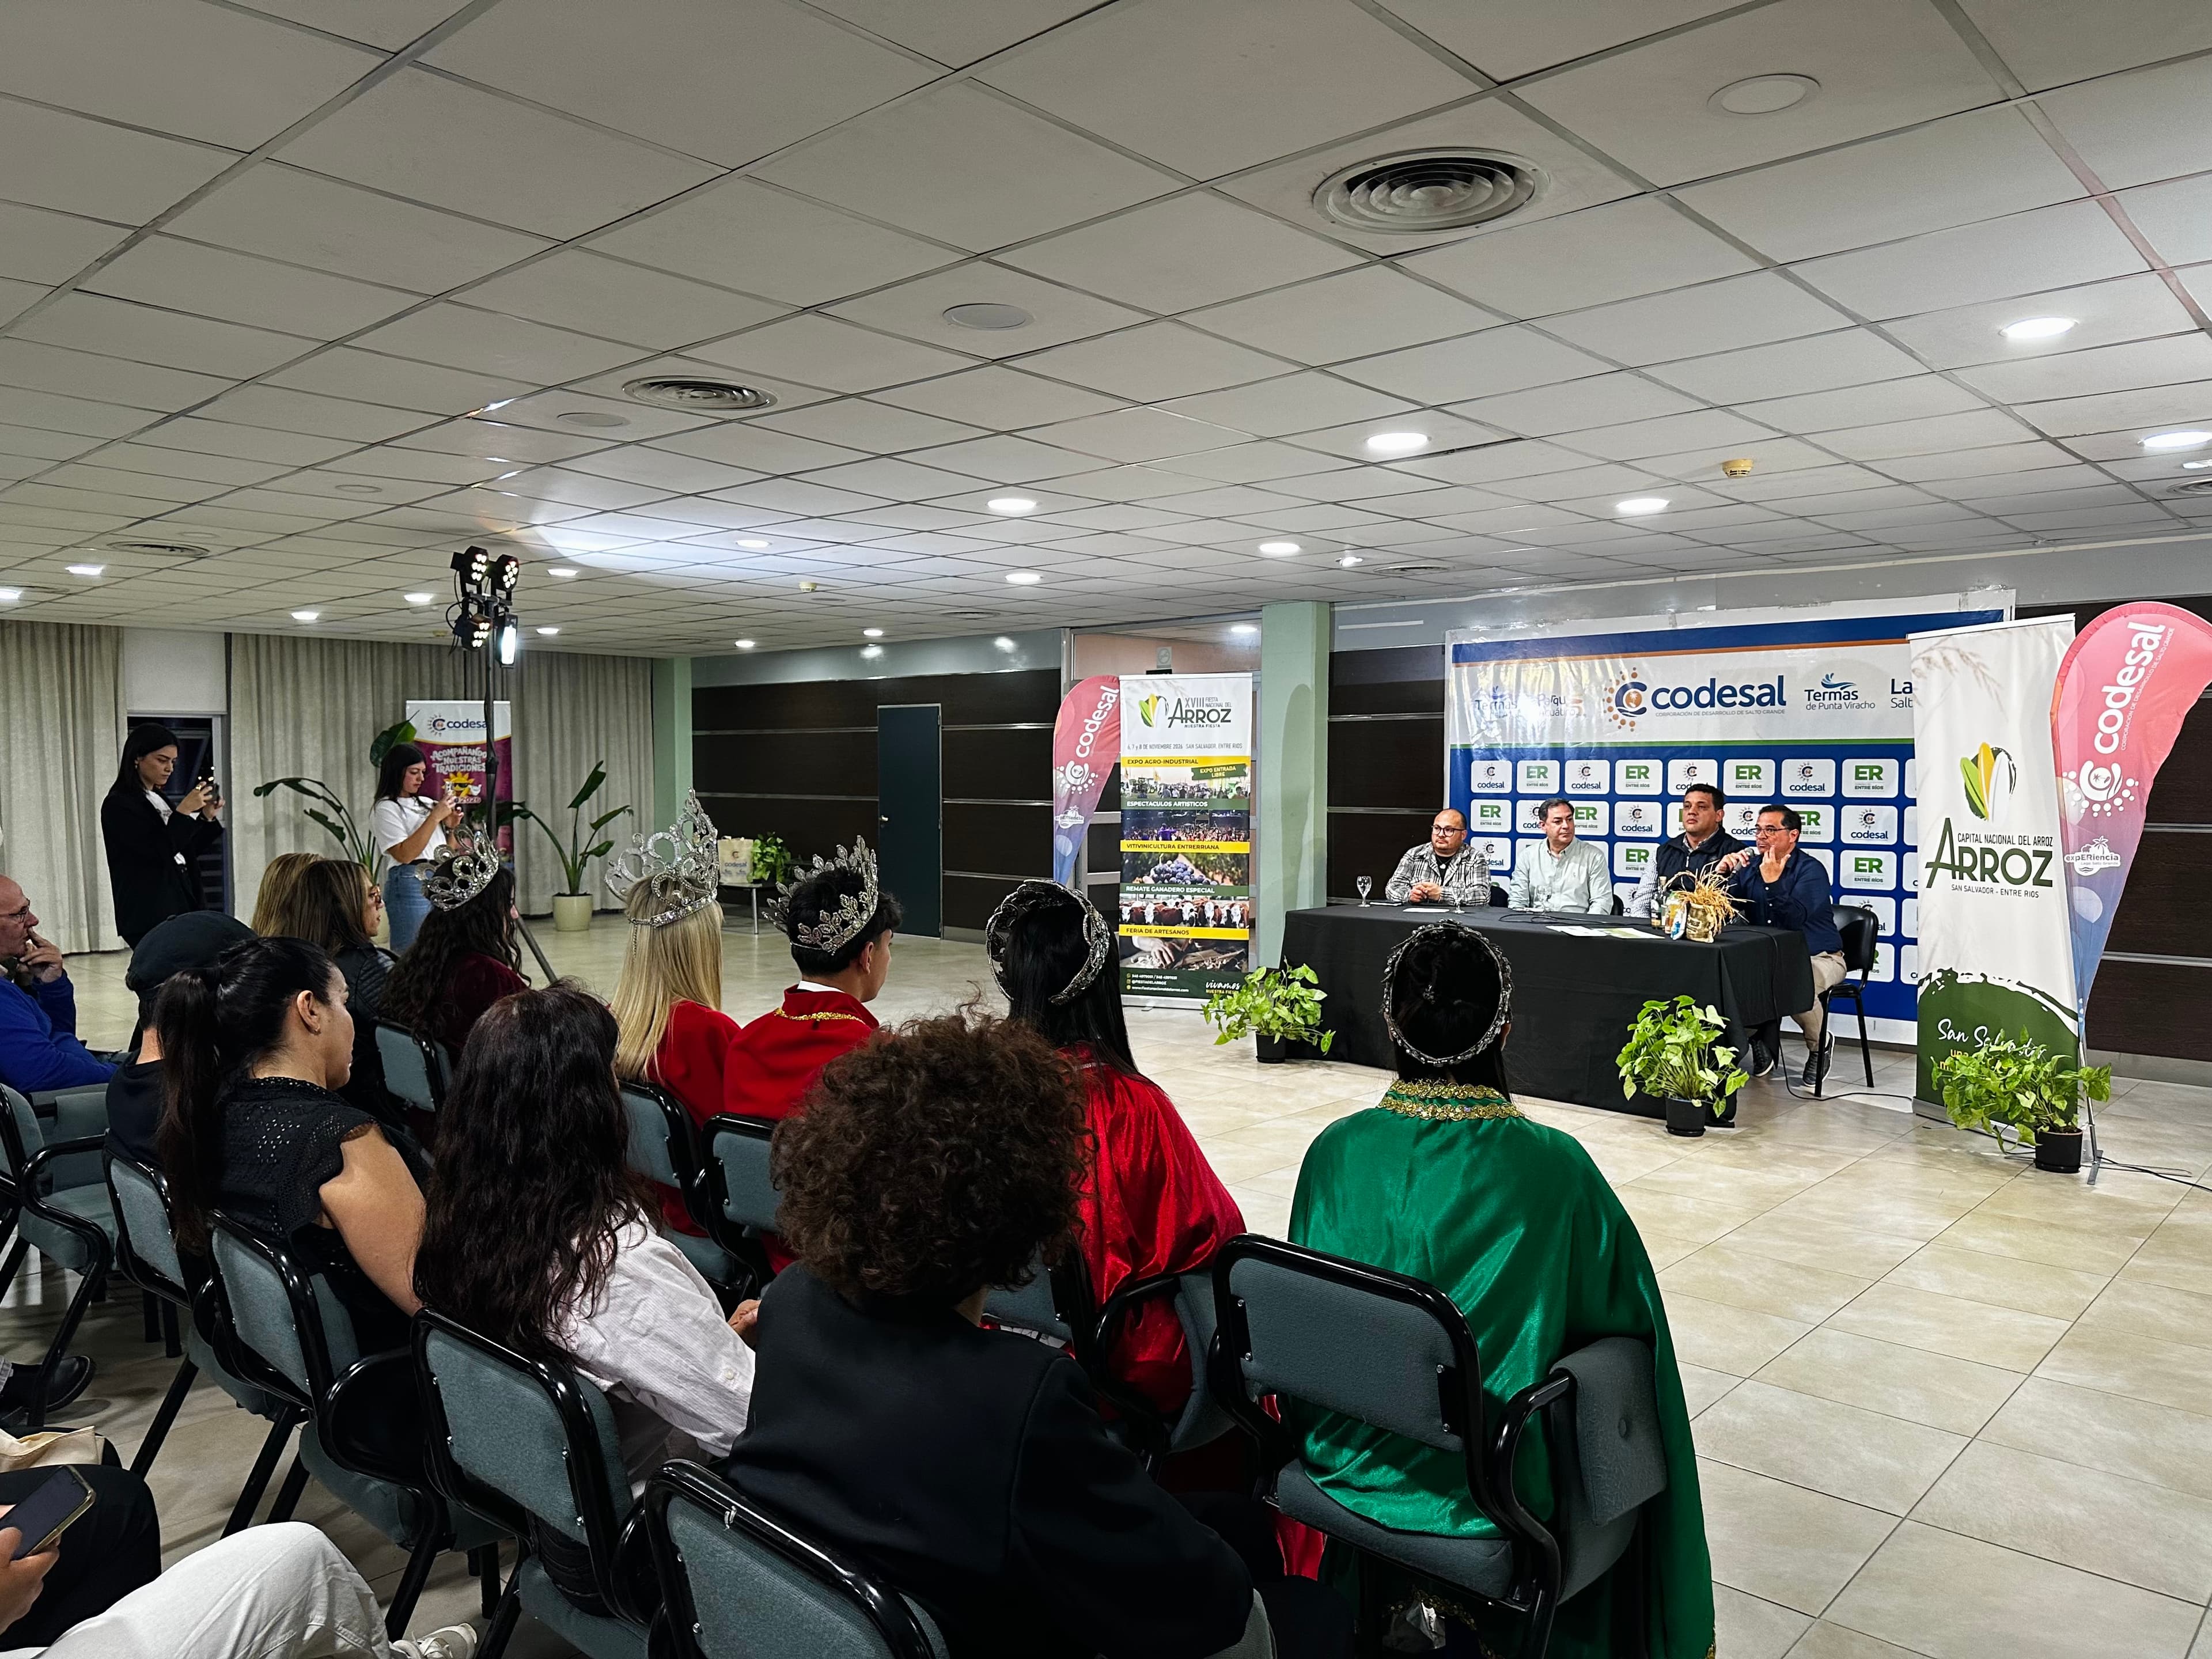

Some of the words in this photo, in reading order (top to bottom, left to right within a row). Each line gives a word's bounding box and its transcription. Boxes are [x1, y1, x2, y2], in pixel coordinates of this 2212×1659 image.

[1652, 675, 1786, 709] codesal
[1891, 679, 1913, 695] La
[2094, 622, 2166, 754] codesal
[1184, 697, 1205, 708] XVIII
[1804, 690, 1858, 702] Termas
[1891, 697, 1913, 708] Salt
[1806, 702, 1816, 710] de
[1844, 701, 1876, 709] Viracho
[1168, 698, 1232, 728] ARROZ
[447, 719, 487, 729] codesa
[1075, 685, 1119, 758] codesal
[444, 755, 482, 766] NUESTRAS
[432, 762, 486, 775] TRADICIONES
[1527, 766, 1548, 779] ER
[1626, 766, 1650, 779] ER
[1736, 765, 1762, 780] ER
[1854, 765, 1884, 781] ER
[1571, 781, 1601, 789] codesal
[1790, 783, 1825, 791] codesal
[1480, 805, 1501, 818] ER
[1575, 806, 1597, 820] ER
[1523, 820, 1541, 828] code
[1622, 824, 1653, 832] codesal
[1851, 831, 1888, 839] codesal
[1958, 833, 1982, 843] CAPITAL
[1984, 834, 2016, 845] NACIONAL
[2018, 835, 2031, 846] DEL
[2033, 836, 2053, 847] ARROZ
[1626, 849, 1649, 862] ER
[1925, 817, 2053, 888] ARROZ
[2066, 854, 2119, 862] expERiencia
[1854, 857, 1883, 873] ER
[1964, 885, 1994, 895] SALVADOR
[2001, 888, 2022, 897] ENTRE
[2024, 889, 2039, 898] RIOS
[1206, 979, 1241, 990] vivamos
[1937, 1018, 1969, 1043] San
